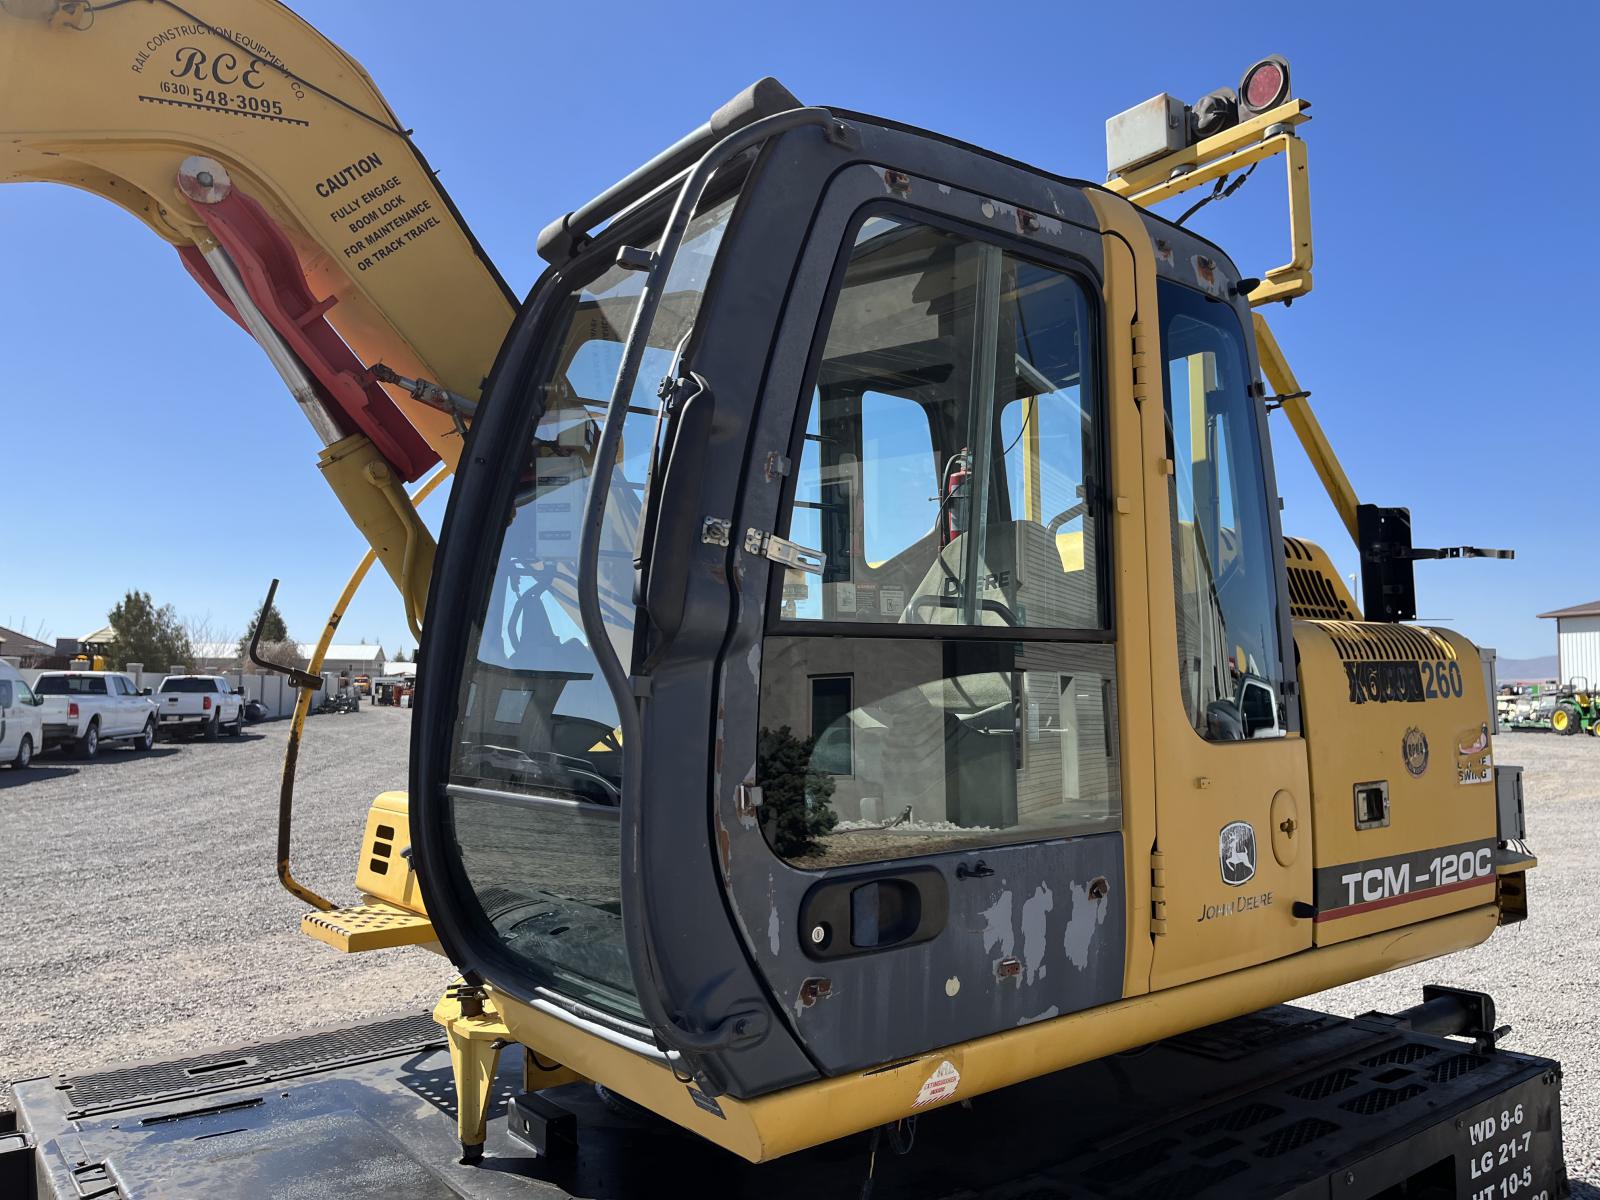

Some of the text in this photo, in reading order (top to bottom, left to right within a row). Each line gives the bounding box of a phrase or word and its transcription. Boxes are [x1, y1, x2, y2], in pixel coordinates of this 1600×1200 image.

[131, 50, 150, 74] RAIL
[235, 32, 290, 79] EQUIPMEN
[170, 46, 265, 90] RCE
[160, 81, 283, 116] (630) 548-3095
[315, 152, 383, 198] CAUTION
[330, 176, 401, 222] FULLY ENGAGE
[349, 195, 406, 234] BOOM LOCK
[344, 200, 432, 258] FOR MAINTENANCE
[357, 216, 440, 271] OR TRACK TRAVEL
[1469, 1103, 1524, 1146] WD 8-6
[1471, 1131, 1532, 1179] LG 21-7
[1500, 1165, 1532, 1198] 10-5
